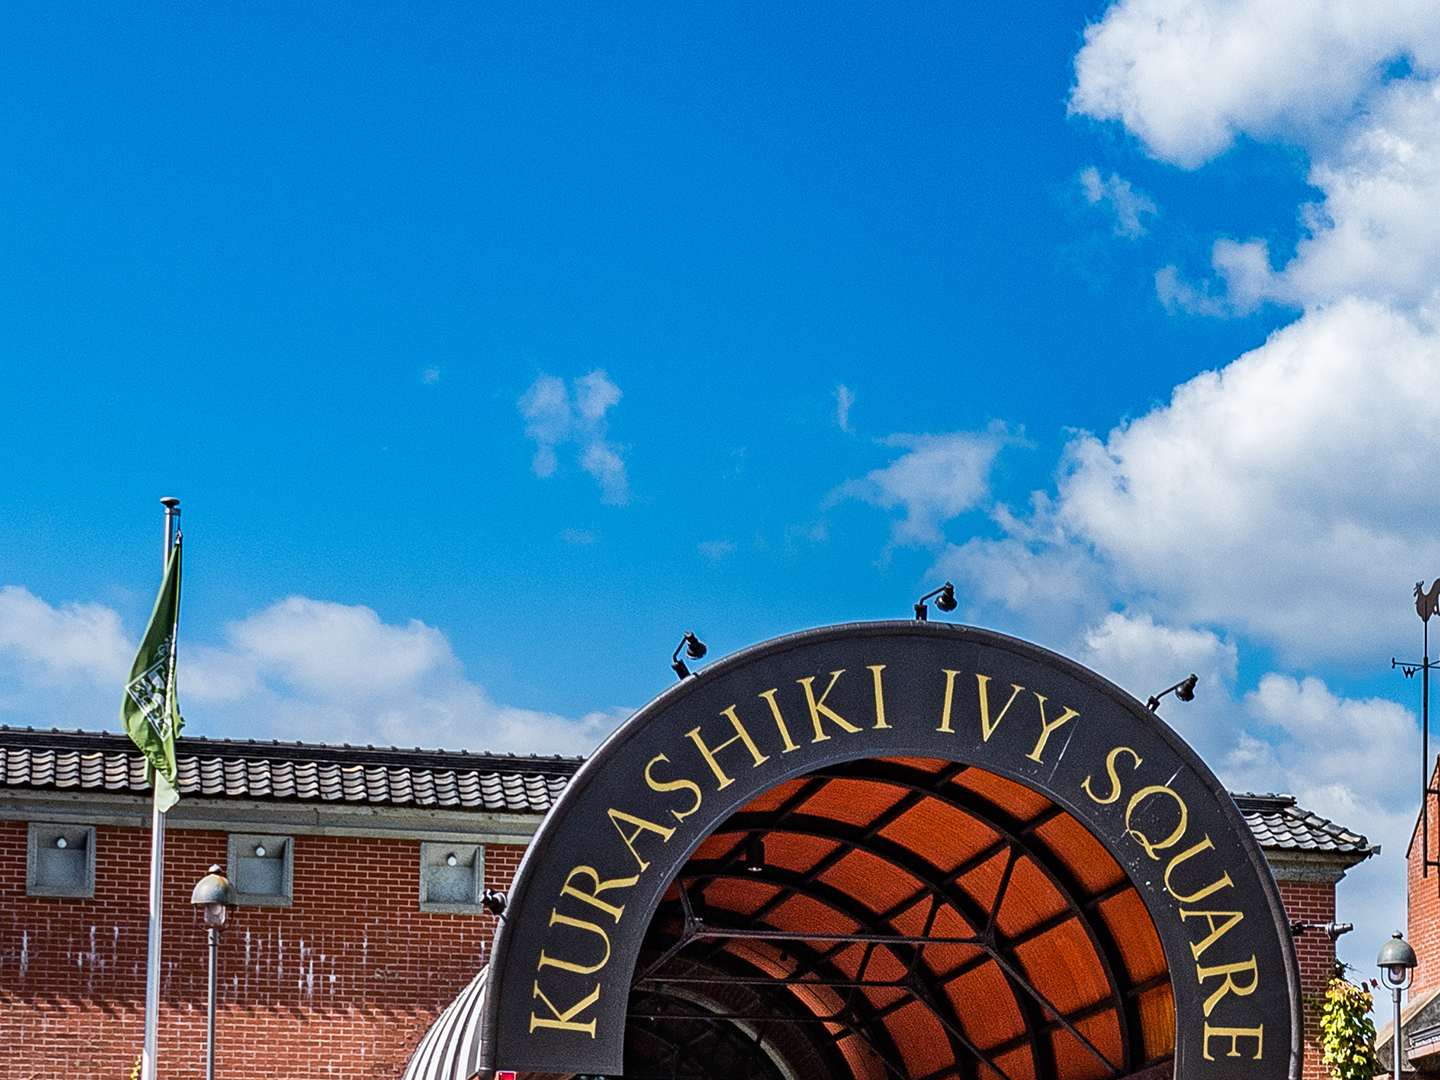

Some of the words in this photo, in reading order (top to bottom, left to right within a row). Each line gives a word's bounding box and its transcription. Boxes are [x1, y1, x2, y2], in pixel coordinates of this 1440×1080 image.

[1402, 666, 1416, 679] W
[529, 665, 892, 1039] KURASHIKI
[936, 669, 1079, 764] IVY
[1081, 747, 1263, 1062] SQUARE
